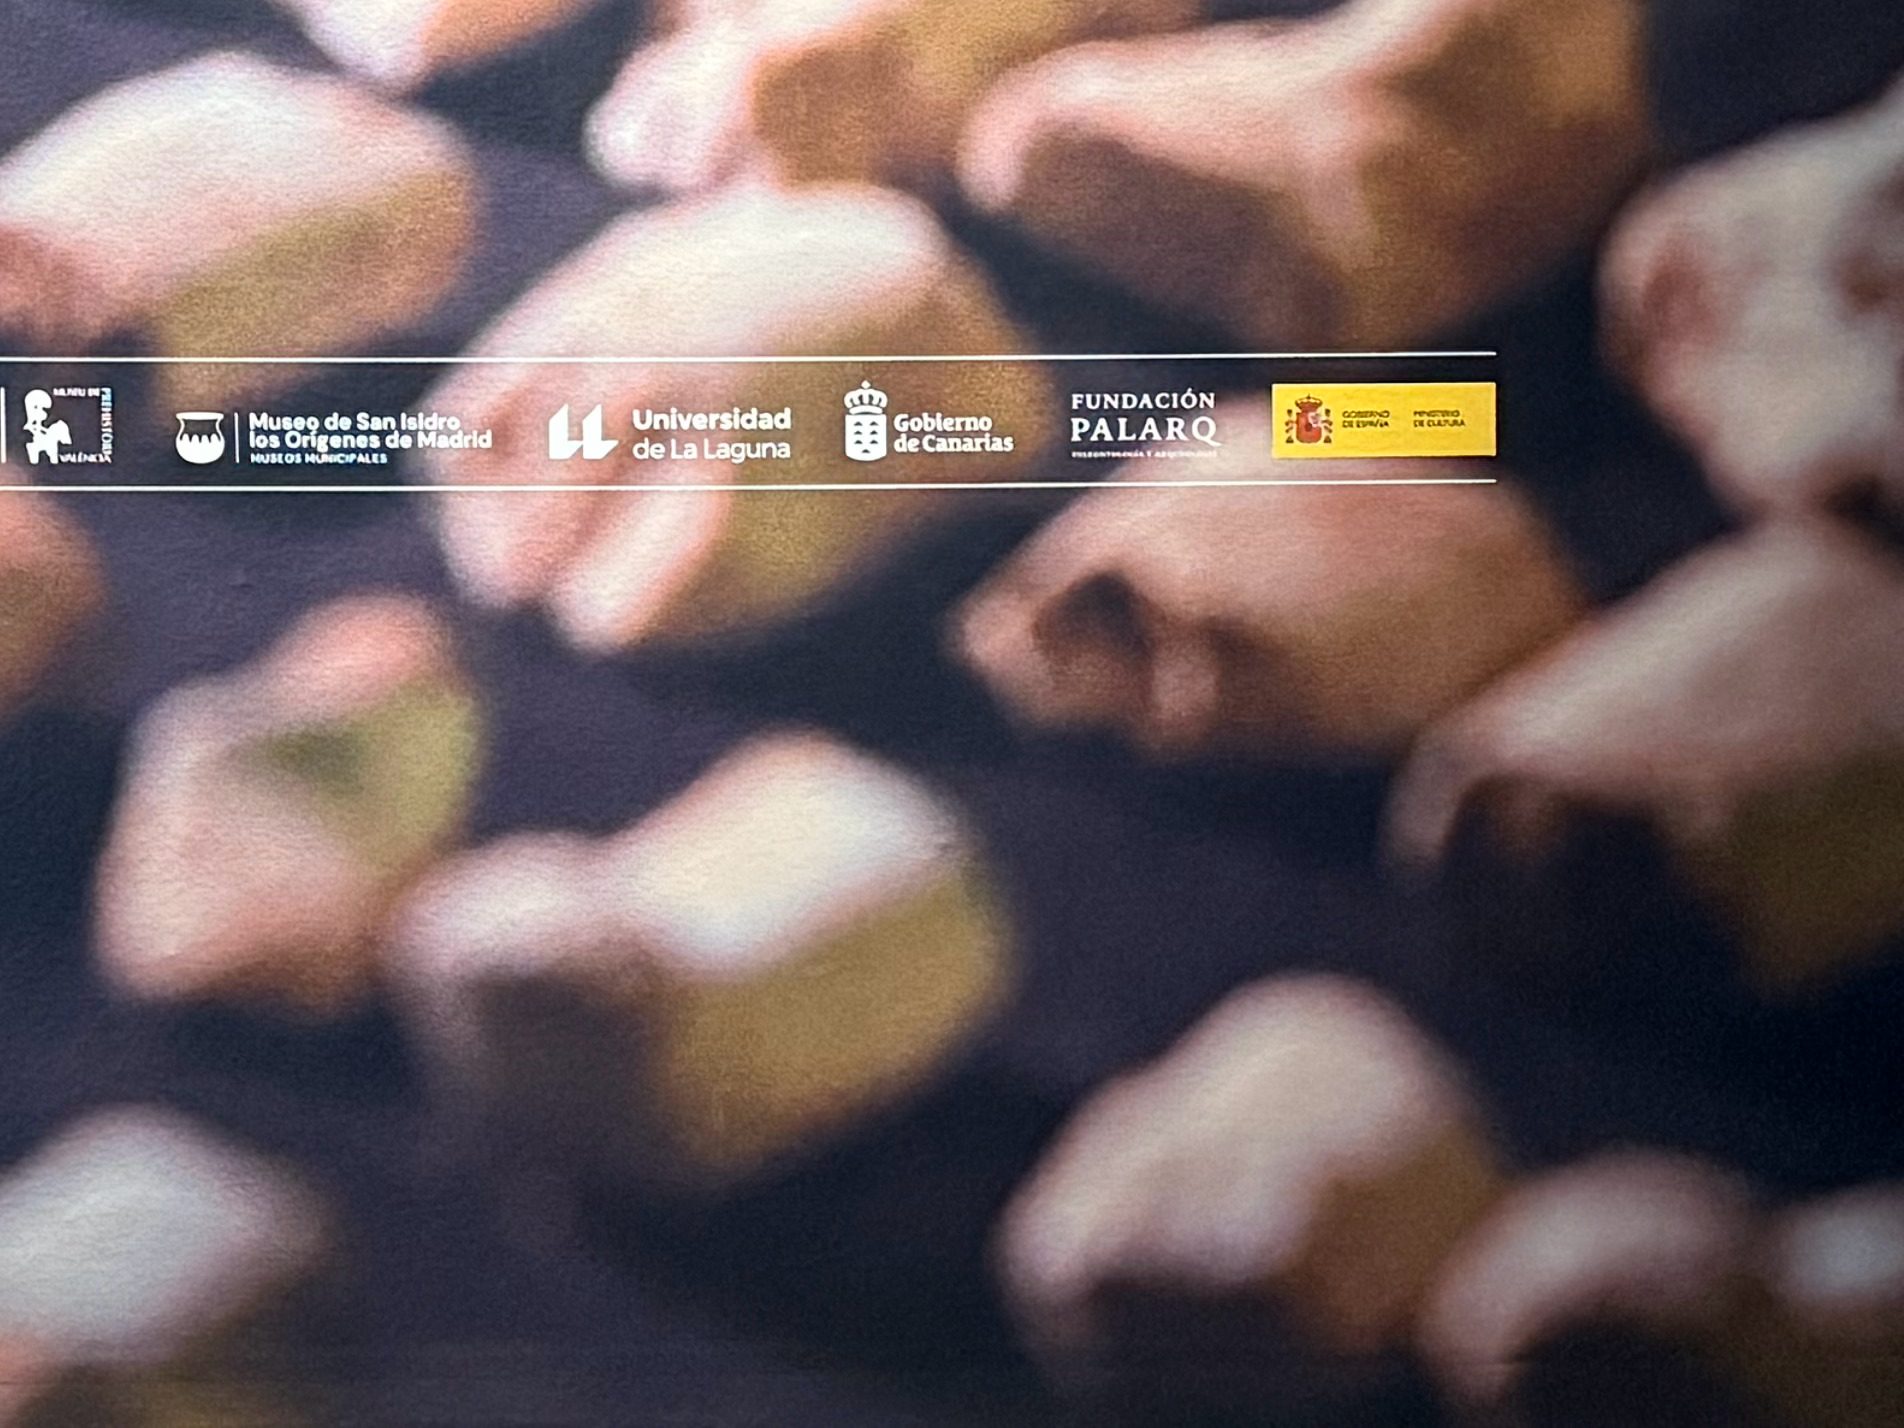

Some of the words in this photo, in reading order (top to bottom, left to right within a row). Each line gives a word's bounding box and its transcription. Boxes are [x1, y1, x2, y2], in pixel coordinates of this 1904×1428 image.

[1071, 387, 1215, 410] FUNDACIÓN
[249, 412, 318, 431] Museo
[324, 412, 349, 431] de
[356, 412, 396, 431] San
[400, 412, 461, 431] Isidro
[632, 407, 791, 431] Universidad
[894, 412, 993, 432] Gobierno
[249, 430, 280, 449] los
[285, 430, 381, 453] Orígenes
[385, 429, 412, 449] de
[417, 429, 493, 449] Madrid
[894, 433, 919, 453] de
[922, 433, 1014, 454] Canarias
[1070, 416, 1222, 448] PALARQ
[250, 453, 302, 464] MUSEOS
[633, 439, 667, 460] de
[671, 439, 699, 460] La
[704, 438, 791, 464] Laguna
